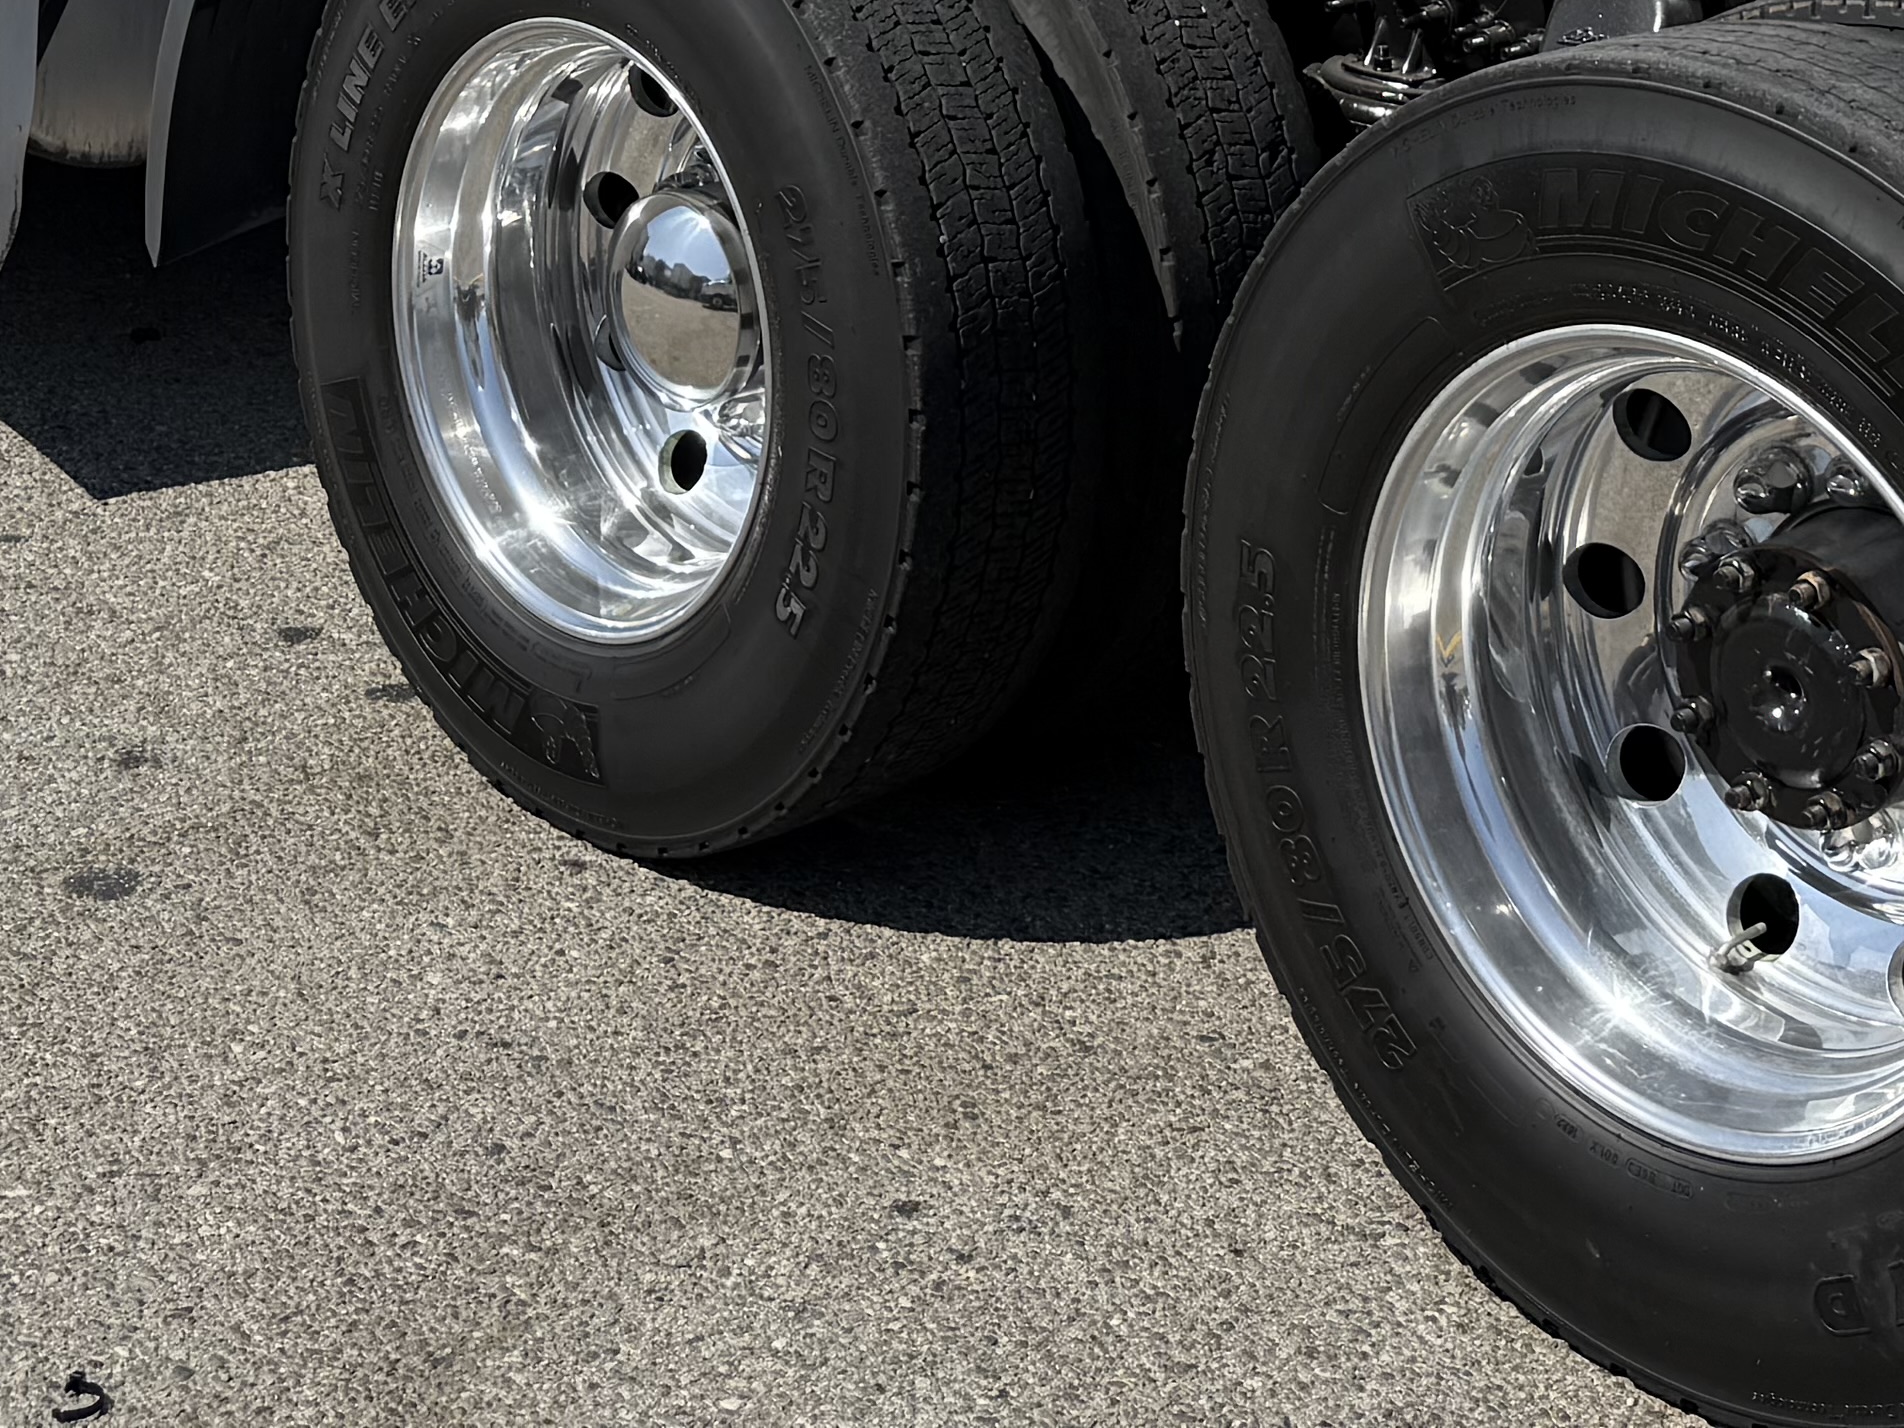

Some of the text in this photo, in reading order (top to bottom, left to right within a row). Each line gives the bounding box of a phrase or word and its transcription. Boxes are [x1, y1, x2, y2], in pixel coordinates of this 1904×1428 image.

[329, 24, 384, 152] LINE
[318, 152, 345, 212] X
[1813, 1273, 1872, 1337] D
